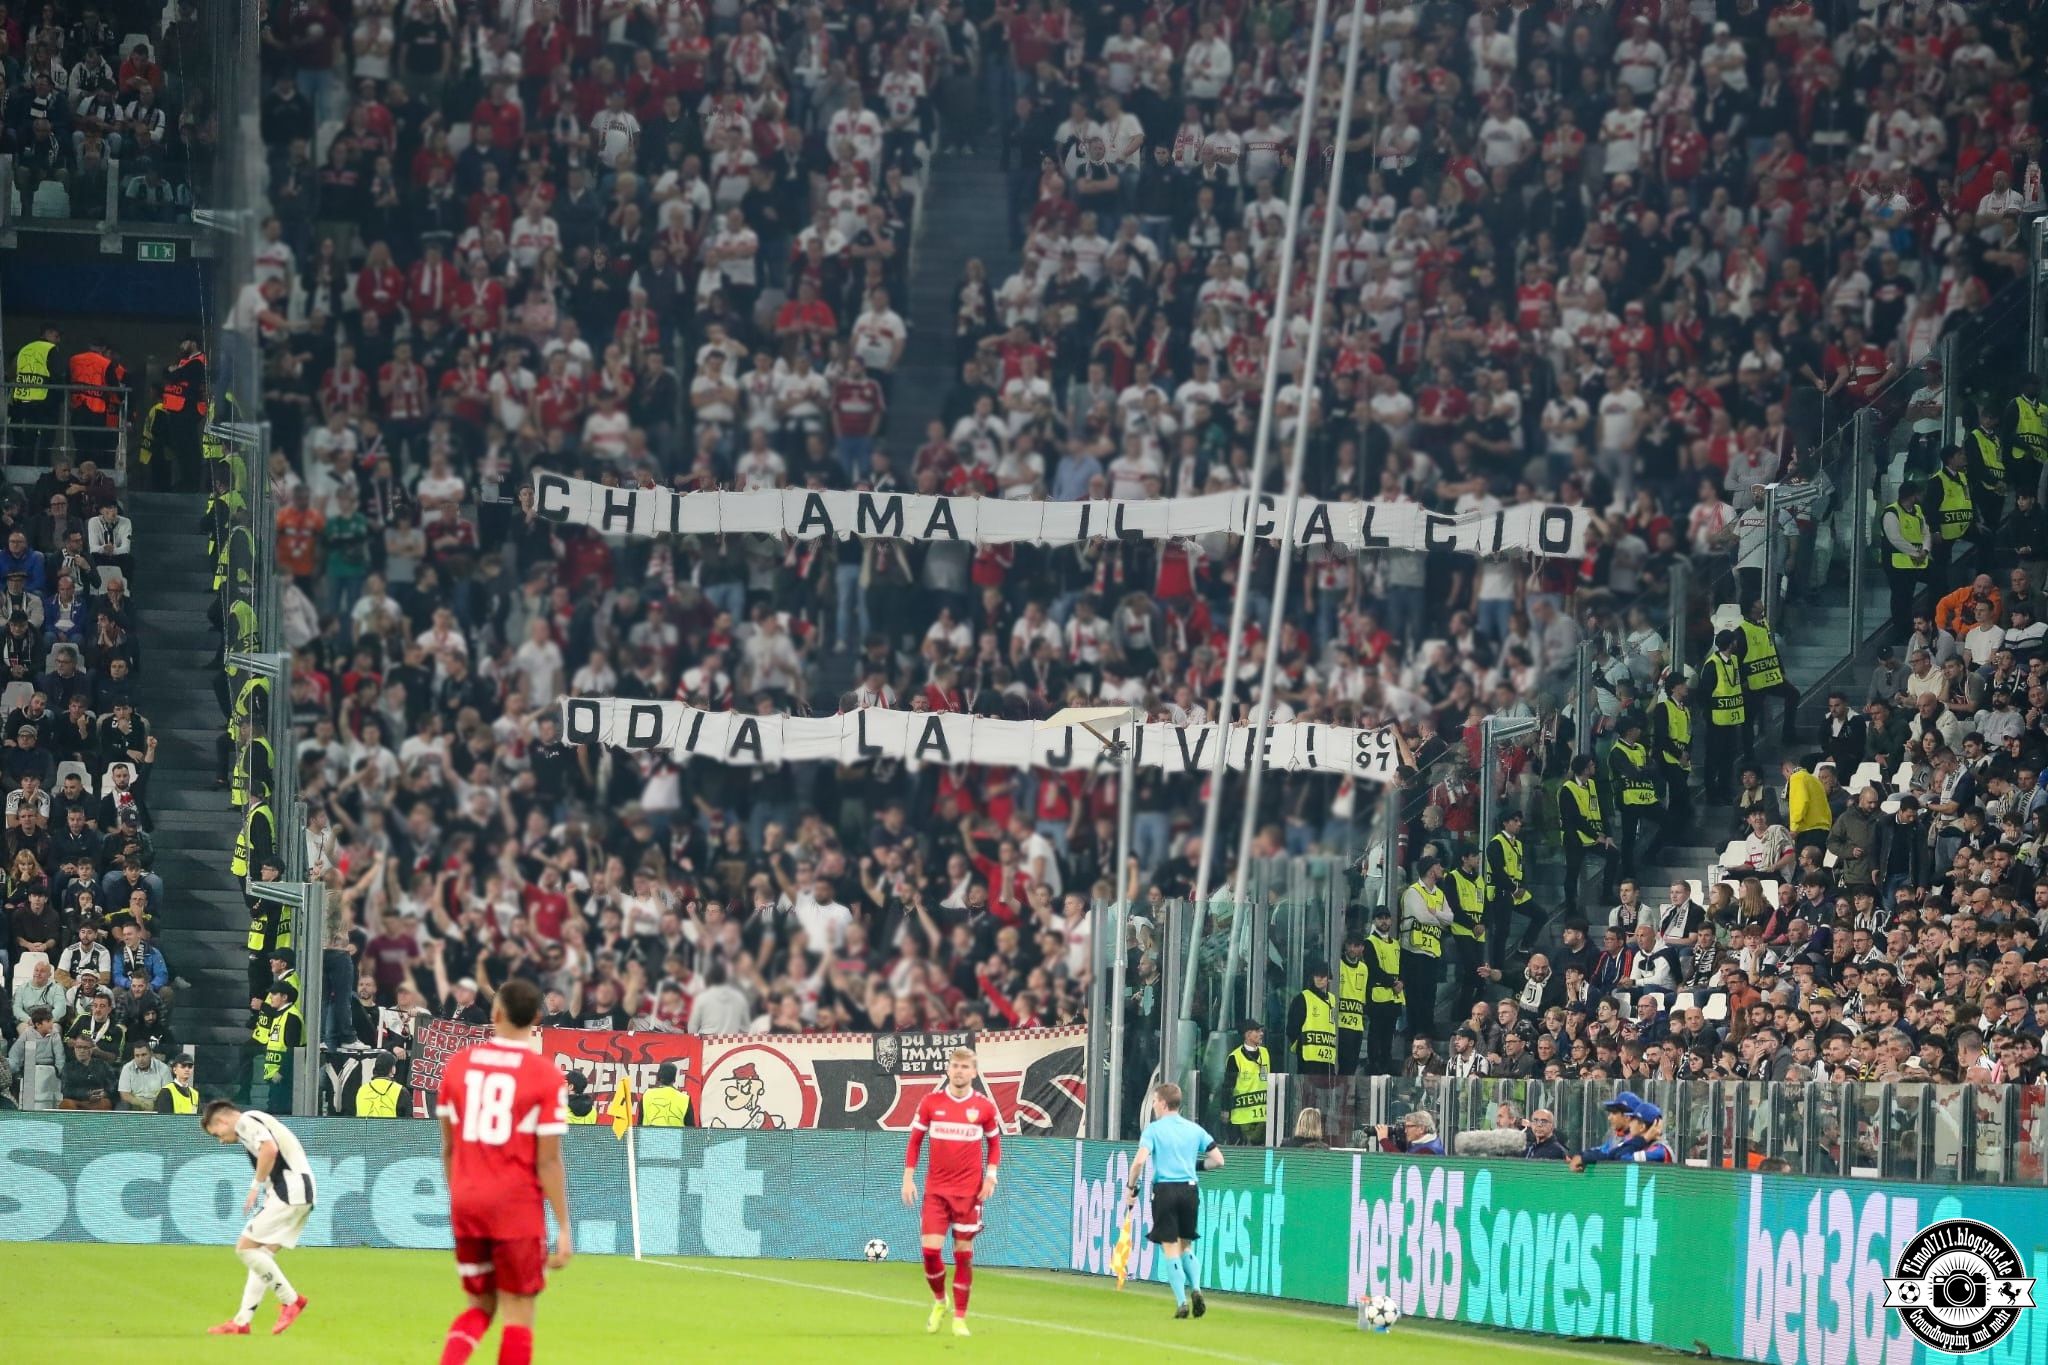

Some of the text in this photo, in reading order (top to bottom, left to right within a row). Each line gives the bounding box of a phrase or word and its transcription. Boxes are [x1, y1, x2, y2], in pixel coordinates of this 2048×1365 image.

[538, 475, 1574, 552] CHI AMA IL CALCIO
[568, 699, 1318, 772] ODIA LA JUVE!
[1357, 731, 1391, 749] CC
[1356, 752, 1388, 771] 97
[901, 1033, 968, 1047] DU BIST
[901, 1046, 968, 1060] IMME
[902, 1061, 926, 1072] BEI
[463, 1069, 516, 1146] 18
[1347, 1154, 1658, 1343] bet365 Scores.it
